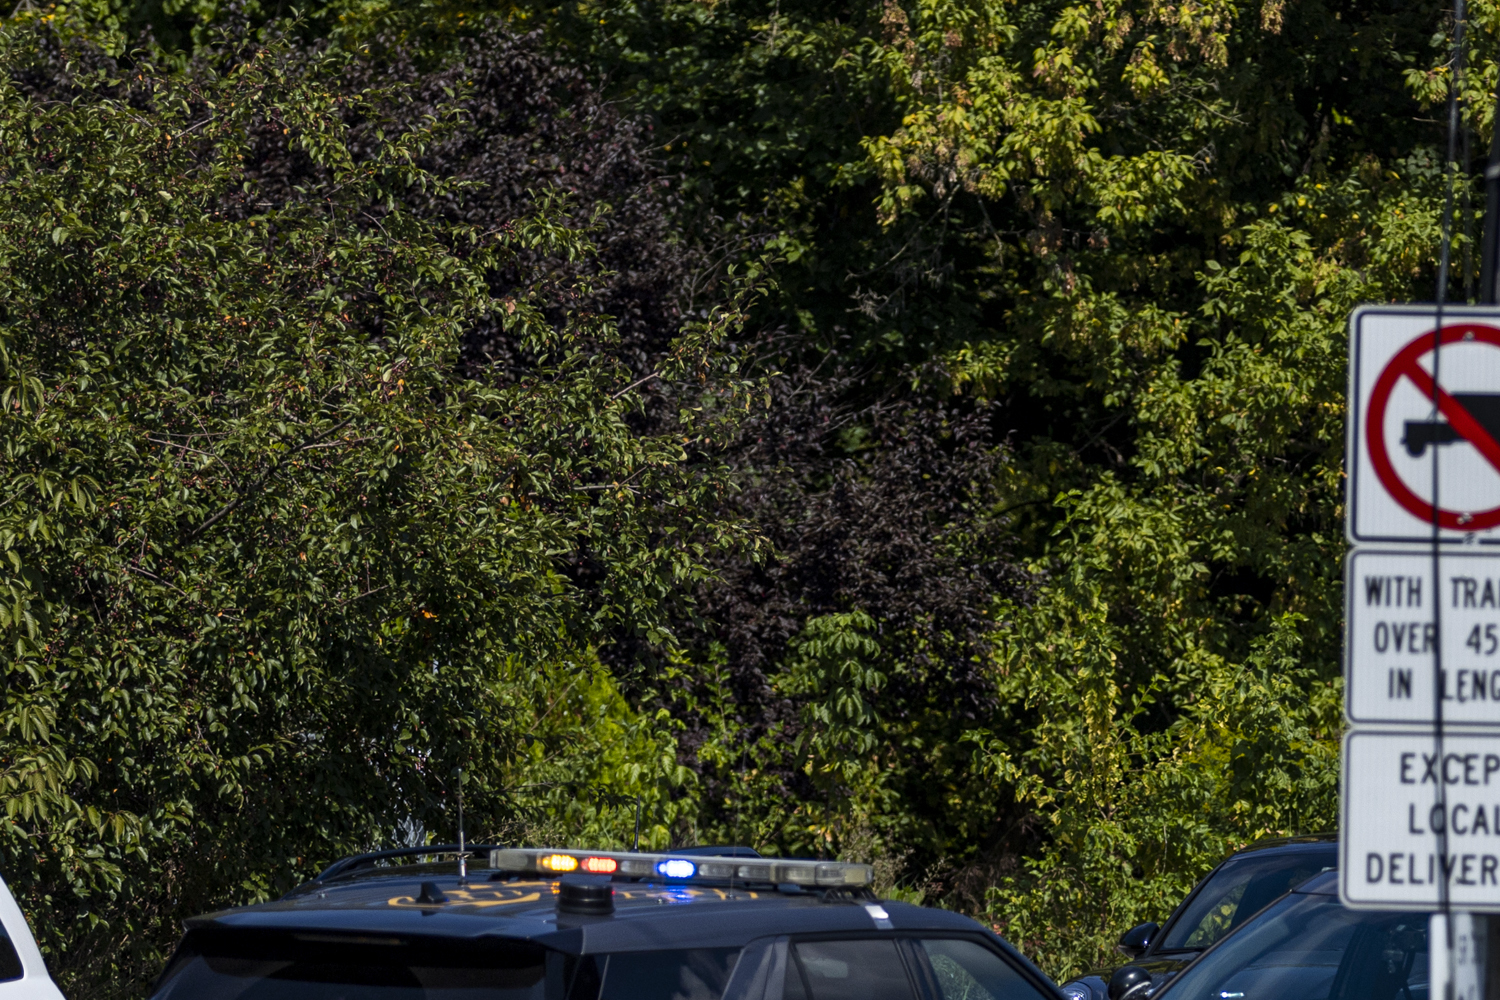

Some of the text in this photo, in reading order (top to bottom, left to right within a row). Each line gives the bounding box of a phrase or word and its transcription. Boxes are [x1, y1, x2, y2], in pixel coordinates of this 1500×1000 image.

[1364, 575, 1422, 608] WITH
[1373, 620, 1437, 654] OVER
[1465, 623, 1499, 656] 45
[1388, 667, 1413, 700] IN
